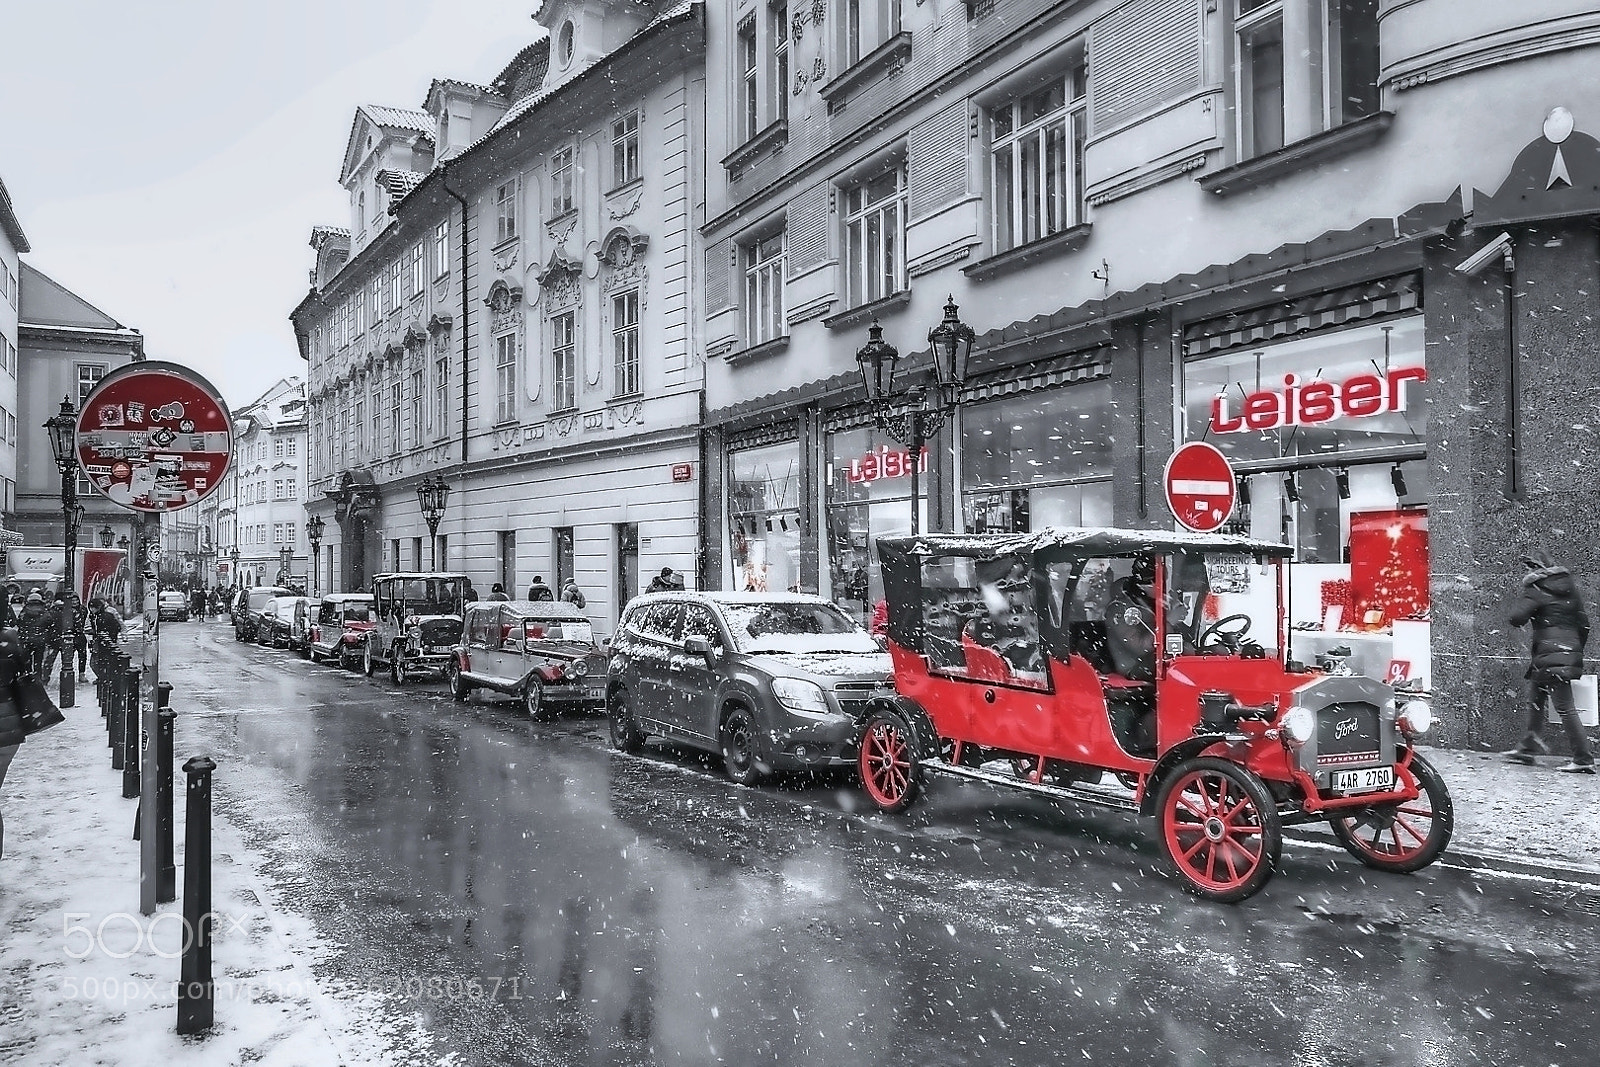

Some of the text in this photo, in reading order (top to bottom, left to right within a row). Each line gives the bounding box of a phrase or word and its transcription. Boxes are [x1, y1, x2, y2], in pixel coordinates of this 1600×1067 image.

[1210, 367, 1426, 434] Leiser
[1216, 565, 1239, 574] TOURS
[1334, 717, 1359, 740] Ford
[1340, 769, 1389, 789] 4AR 2760
